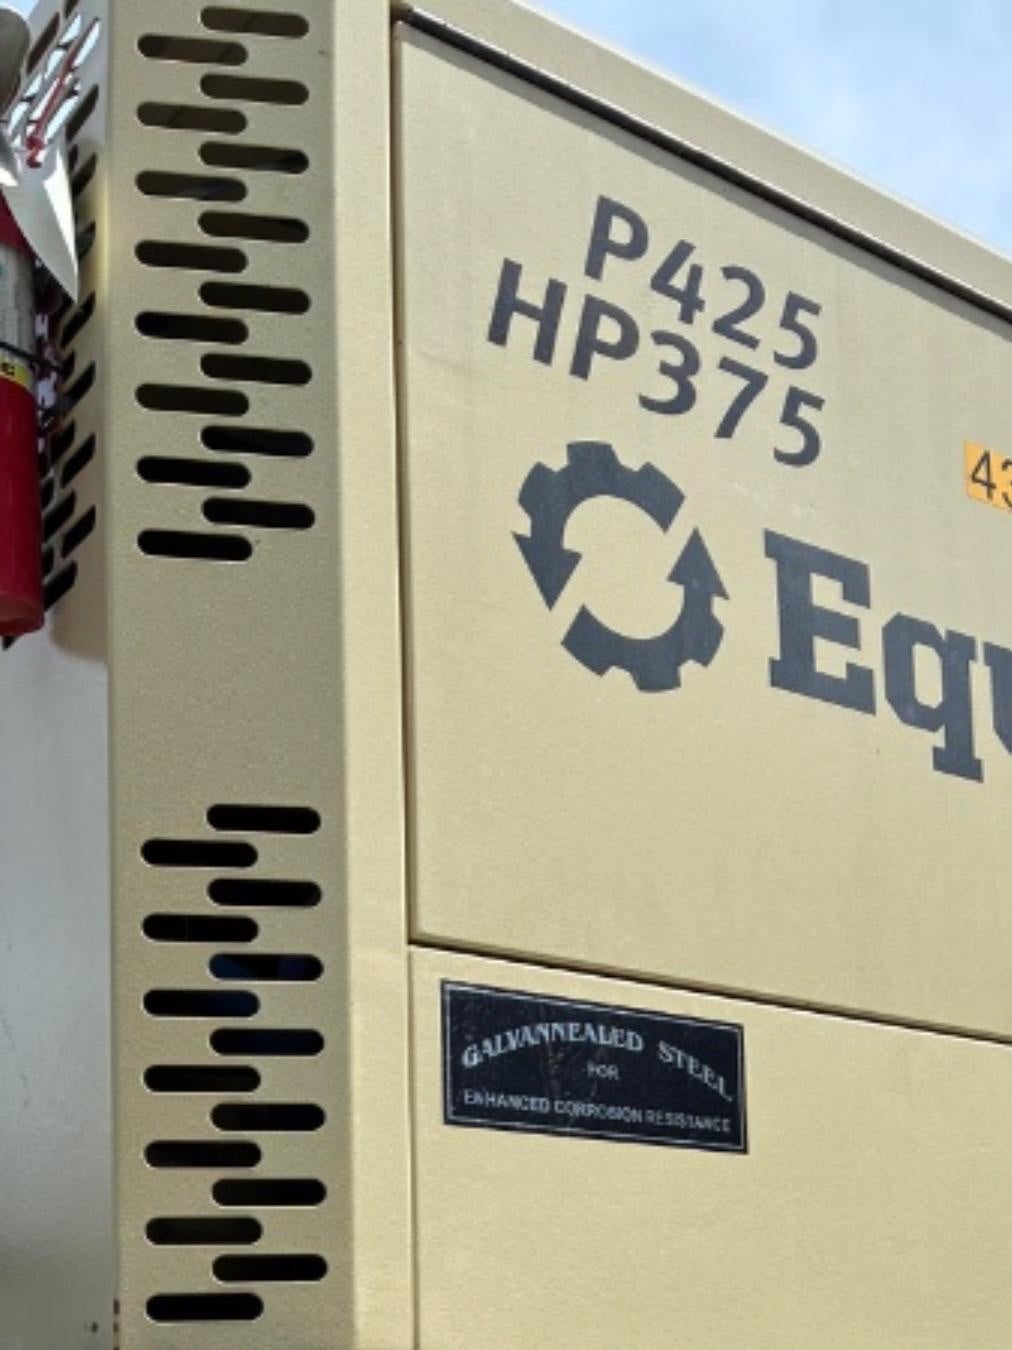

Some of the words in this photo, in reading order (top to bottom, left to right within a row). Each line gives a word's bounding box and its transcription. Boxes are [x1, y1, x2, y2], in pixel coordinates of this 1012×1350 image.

[584, 194, 823, 370] P425
[487, 257, 826, 467] HP375
[461, 1021, 645, 1069] GALVANNEALED
[657, 1040, 734, 1103] STEEL
[585, 1061, 620, 1081] FOR
[464, 1089, 550, 1115] ENHANCED
[554, 1098, 644, 1124] CORROSION
[645, 1109, 732, 1133] RESISTANCE
